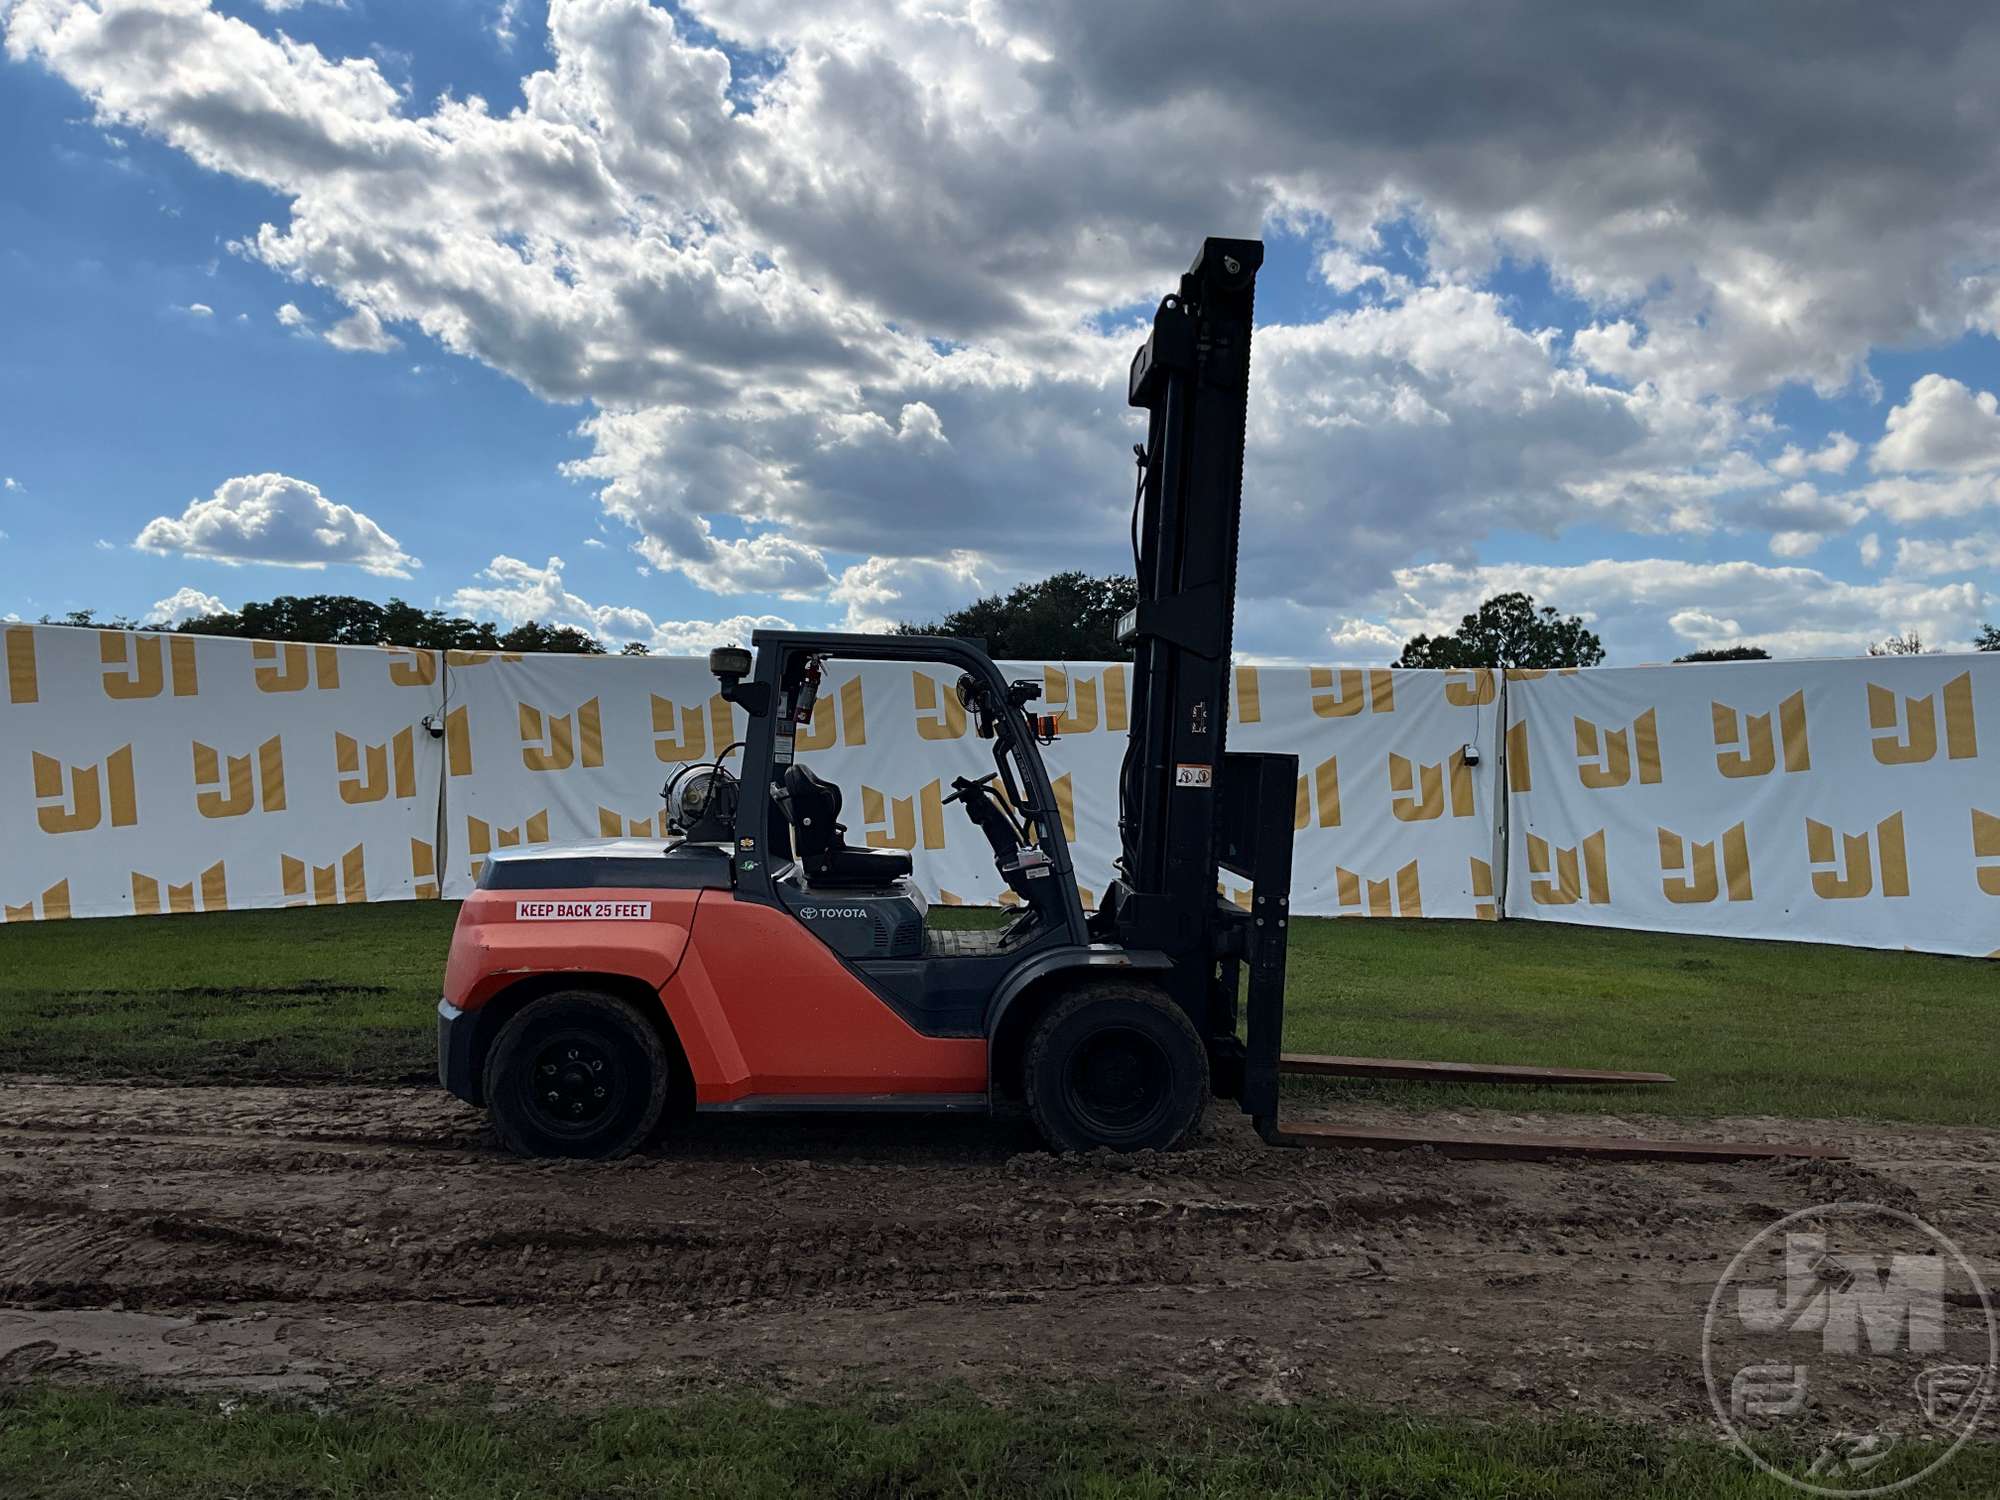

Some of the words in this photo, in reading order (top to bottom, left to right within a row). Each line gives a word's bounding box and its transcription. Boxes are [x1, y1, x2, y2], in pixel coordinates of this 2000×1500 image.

[521, 904, 554, 917] KEEP
[557, 904, 592, 917] BACK
[595, 904, 611, 917] 25
[615, 904, 647, 917] FEET
[819, 908, 867, 918] TOYOTA
